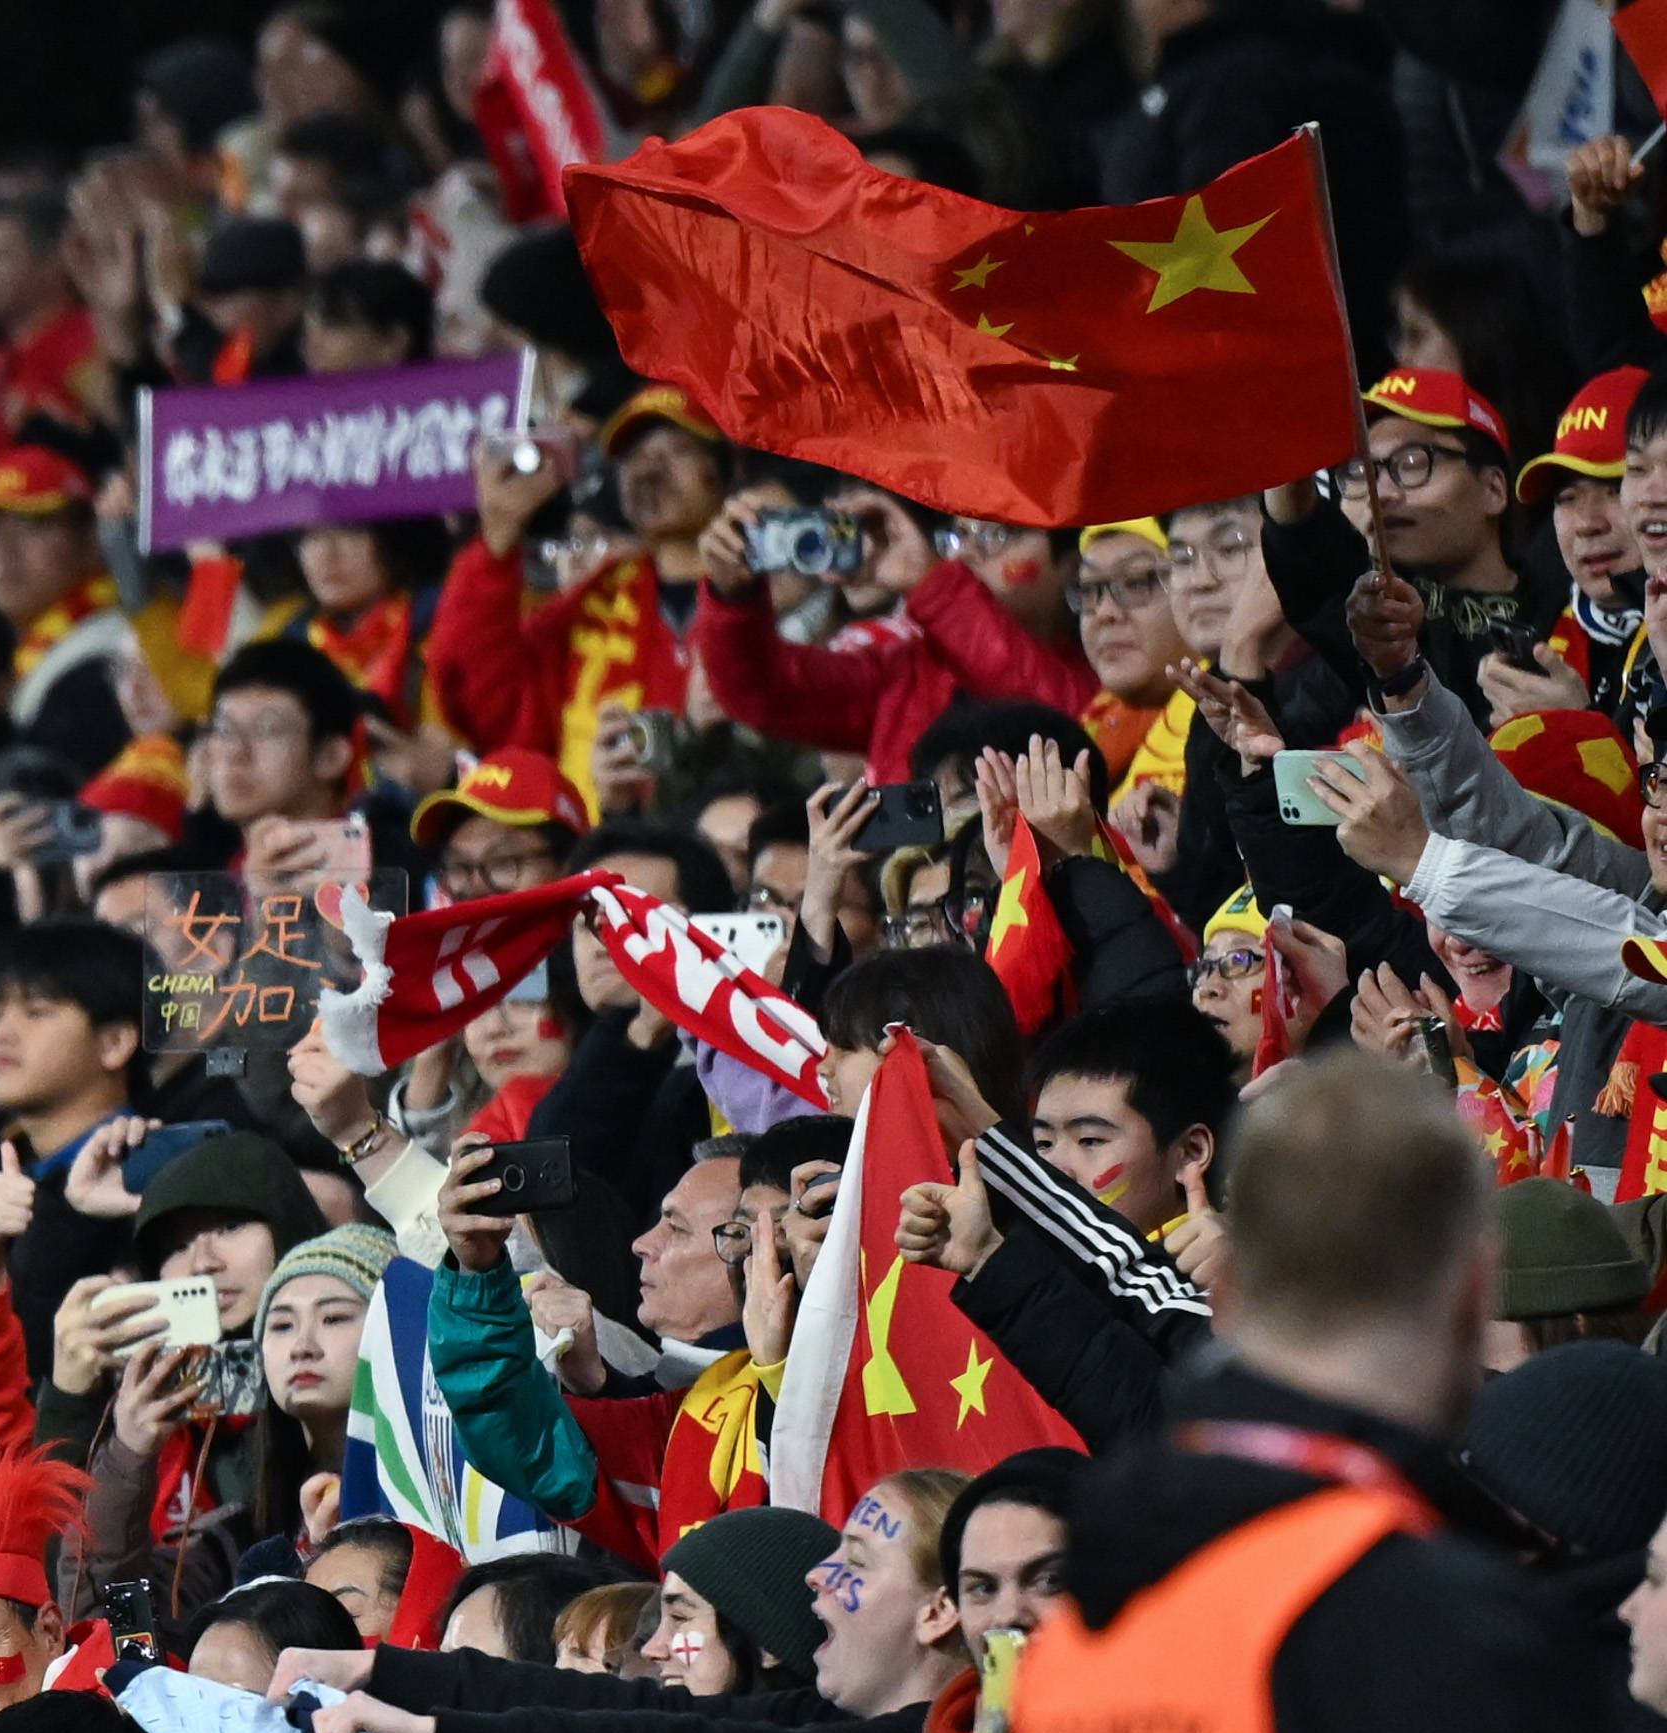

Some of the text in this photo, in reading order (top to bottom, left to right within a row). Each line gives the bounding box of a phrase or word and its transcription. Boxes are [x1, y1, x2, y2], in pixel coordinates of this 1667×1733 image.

[163, 889, 323, 968] 女足
[147, 973, 216, 995] CHINA
[197, 968, 337, 1042] 加
